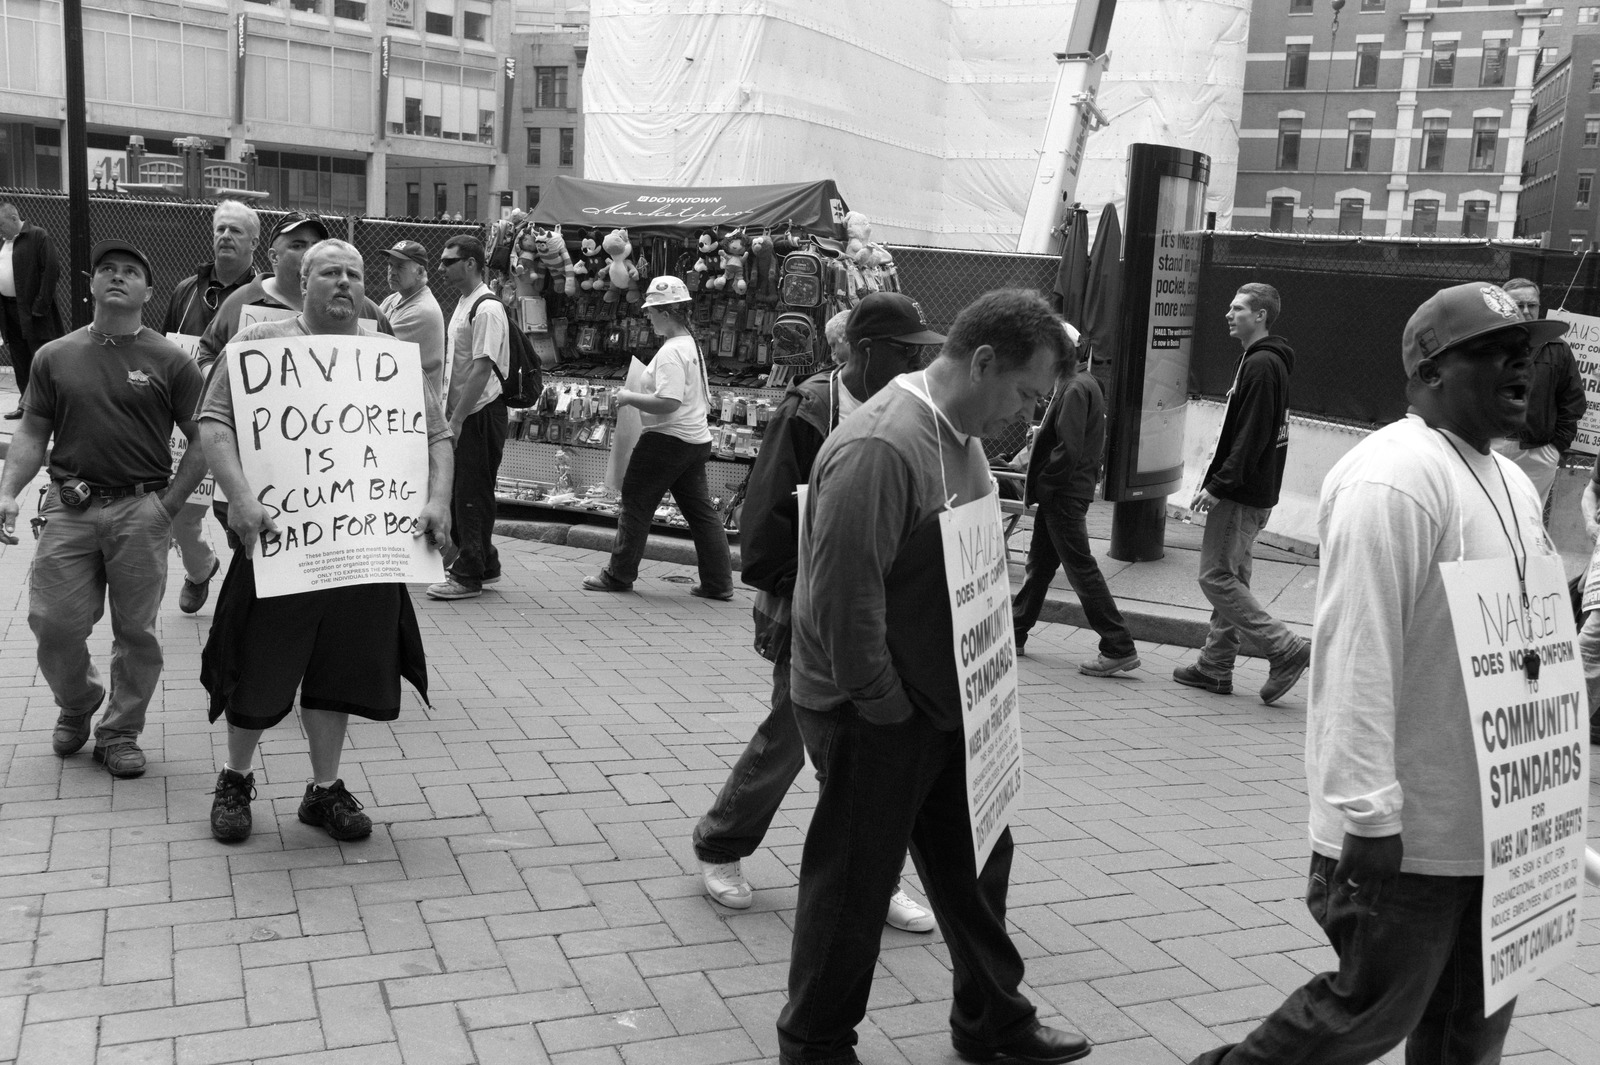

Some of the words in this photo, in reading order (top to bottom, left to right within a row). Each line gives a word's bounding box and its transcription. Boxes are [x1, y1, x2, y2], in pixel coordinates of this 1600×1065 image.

[1069, 85, 1096, 177] Link-Bt
[1161, 229, 1175, 248] It's
[1158, 254, 1183, 272] stand
[1155, 276, 1186, 298] pocket,
[1154, 302, 1178, 317] more
[1570, 342, 1585, 352] NOT
[239, 347, 398, 394] DAVID
[252, 403, 426, 450] POGORELC
[304, 447, 335, 475] IS
[363, 445, 378, 468] A
[257, 478, 355, 520] SCUM
[369, 478, 417, 500] BAG
[259, 521, 323, 557] BAD
[333, 513, 377, 541] FOR
[322, 549, 345, 557] banners
[326, 556, 346, 564] protest
[303, 564, 334, 573] corporation
[343, 560, 370, 568] organized
[332, 573, 369, 582] INDIVIDUALS
[342, 567, 370, 575] EXPRESS
[956, 581, 975, 608] DOES
[977, 572, 988, 596] NOT
[987, 597, 993, 610] TO
[961, 596, 1010, 668] COMMUNITY
[1477, 592, 1562, 646] NAUSET
[965, 637, 1013, 711] STANDARDS
[1471, 652, 1505, 678] DOES
[1528, 680, 1539, 694] TO
[1481, 691, 1580, 753] COMMUNITY
[1489, 742, 1581, 808] STANDARDS
[1531, 802, 1546, 820] FOR
[1554, 806, 1583, 842] BENEFITS
[1522, 860, 1535, 876] SIGN
[1536, 856, 1542, 869] IS
[1490, 933, 1529, 986] DISTRICT
[1530, 914, 1563, 960] COUNCIL
[1564, 908, 1576, 939] 35
